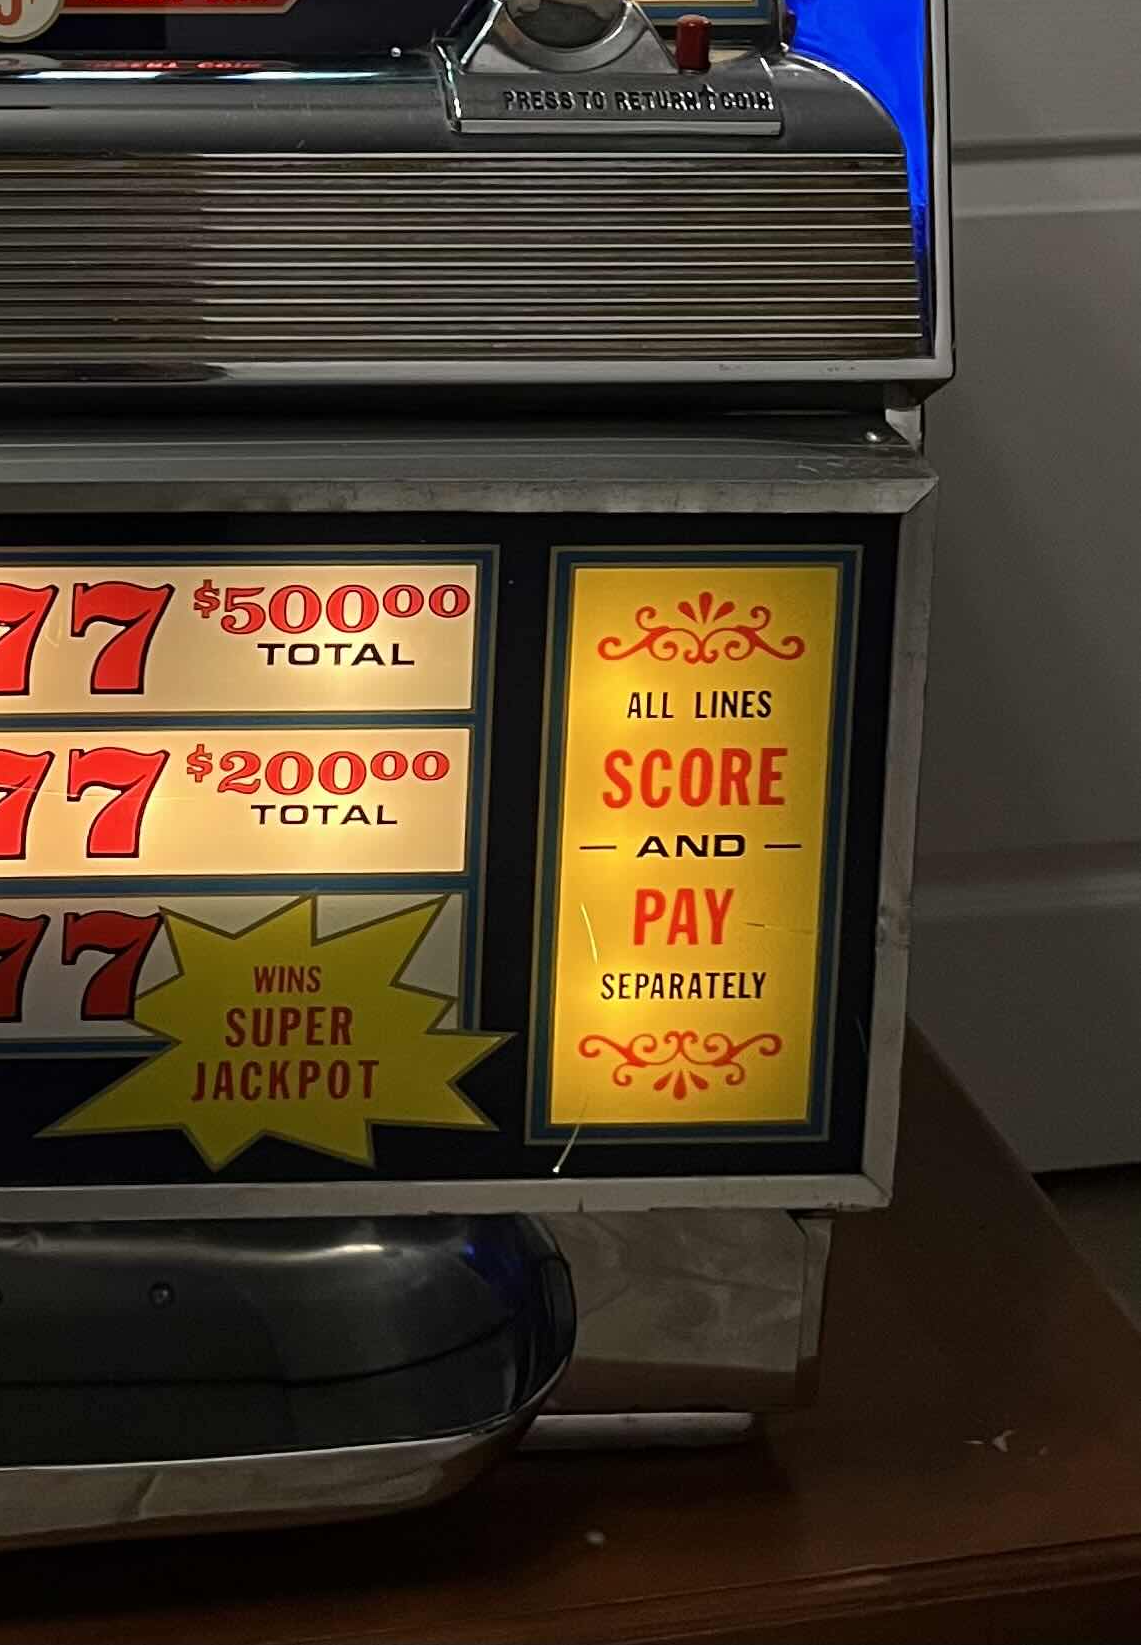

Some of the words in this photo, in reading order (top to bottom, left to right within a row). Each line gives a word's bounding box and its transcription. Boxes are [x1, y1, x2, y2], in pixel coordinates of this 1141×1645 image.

[502, 91, 572, 110] PRESS
[578, 91, 604, 110] TO
[257, 643, 415, 666] TOTAL
[627, 691, 674, 718] ALL
[695, 690, 773, 718] LINES
[602, 747, 789, 809] SCORE
[251, 804, 398, 825] TOTAL
[637, 834, 746, 858] AND
[632, 888, 735, 945] PAY
[253, 965, 321, 993] WINS
[600, 971, 768, 999] SEPARATELY
[225, 1006, 353, 1048] SUPER
[191, 1060, 379, 1101] JACKPOT
